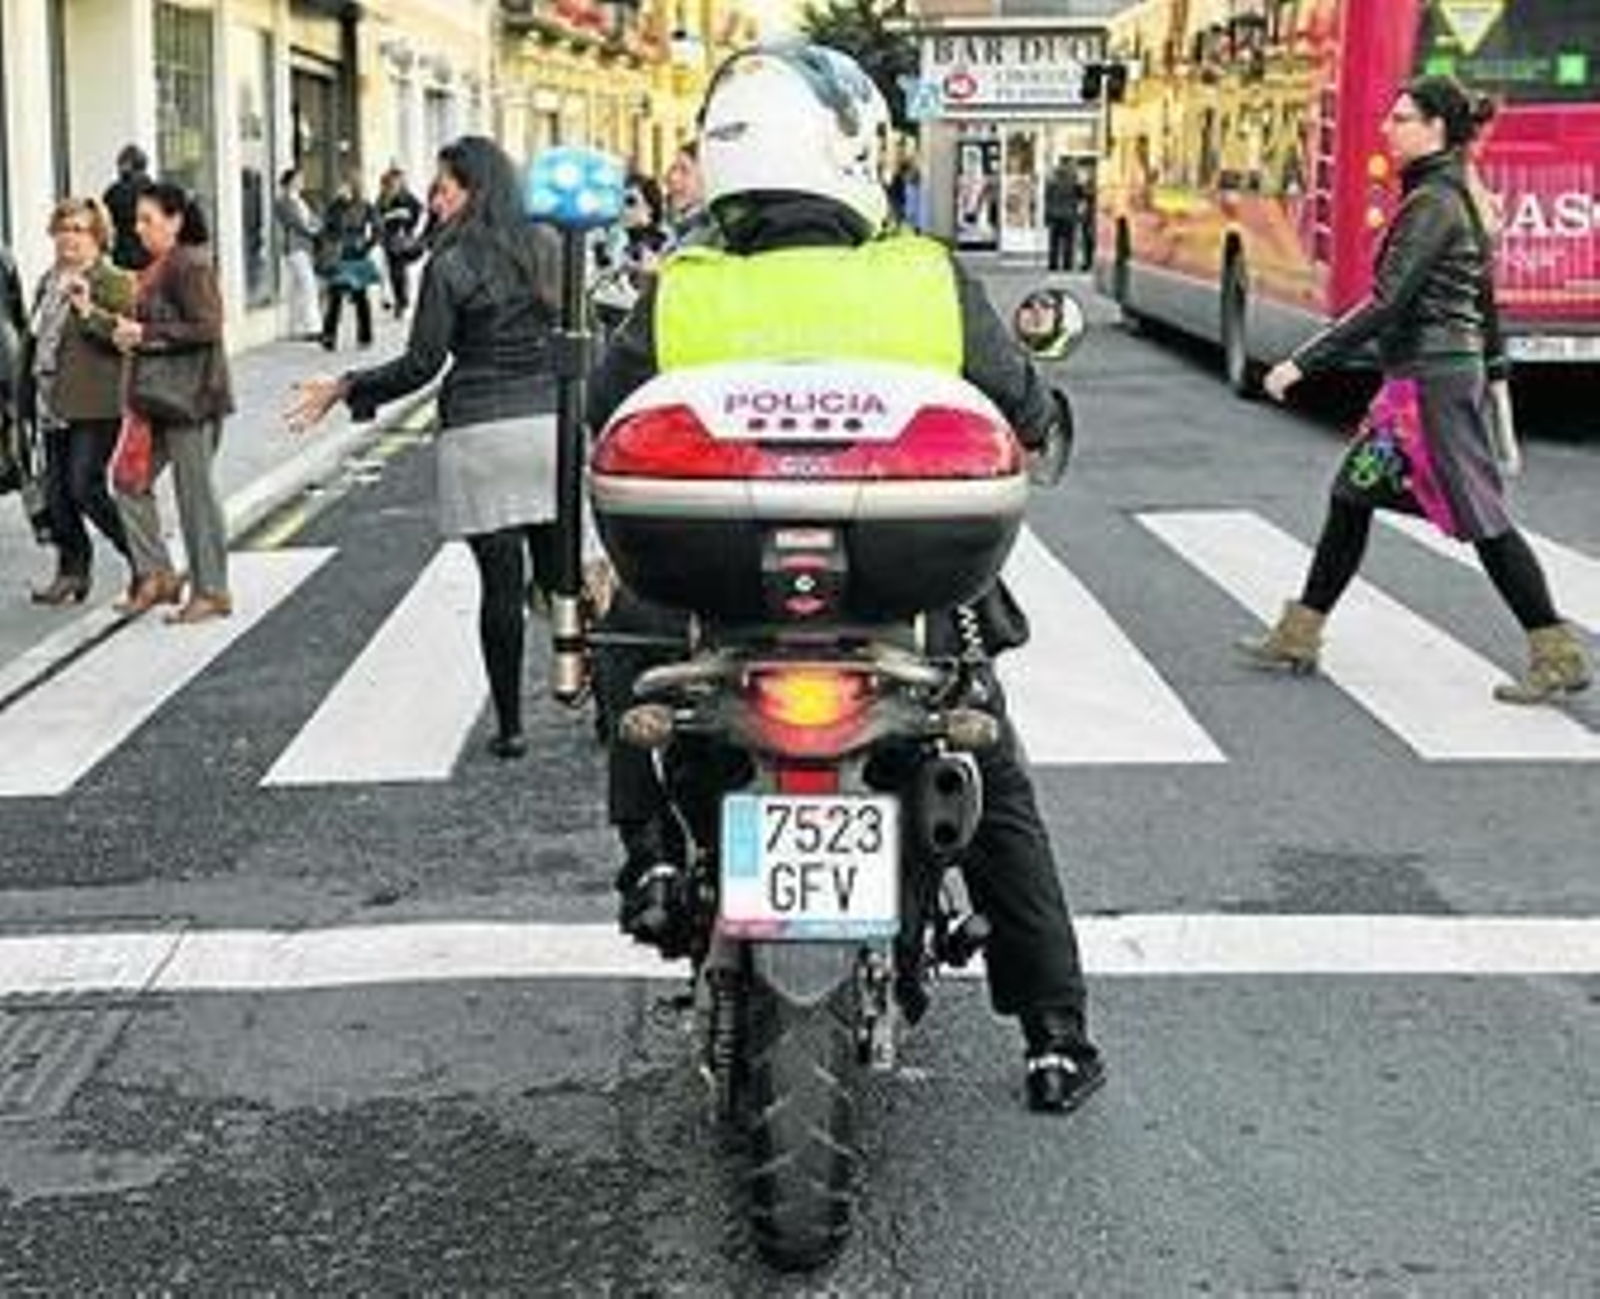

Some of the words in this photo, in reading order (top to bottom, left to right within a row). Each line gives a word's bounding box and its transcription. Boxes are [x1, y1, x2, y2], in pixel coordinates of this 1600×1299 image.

[933, 37, 1003, 64] BAR
[724, 391, 886, 415] POLICIA
[765, 804, 883, 854] 7523
[769, 862, 858, 913] GFV
